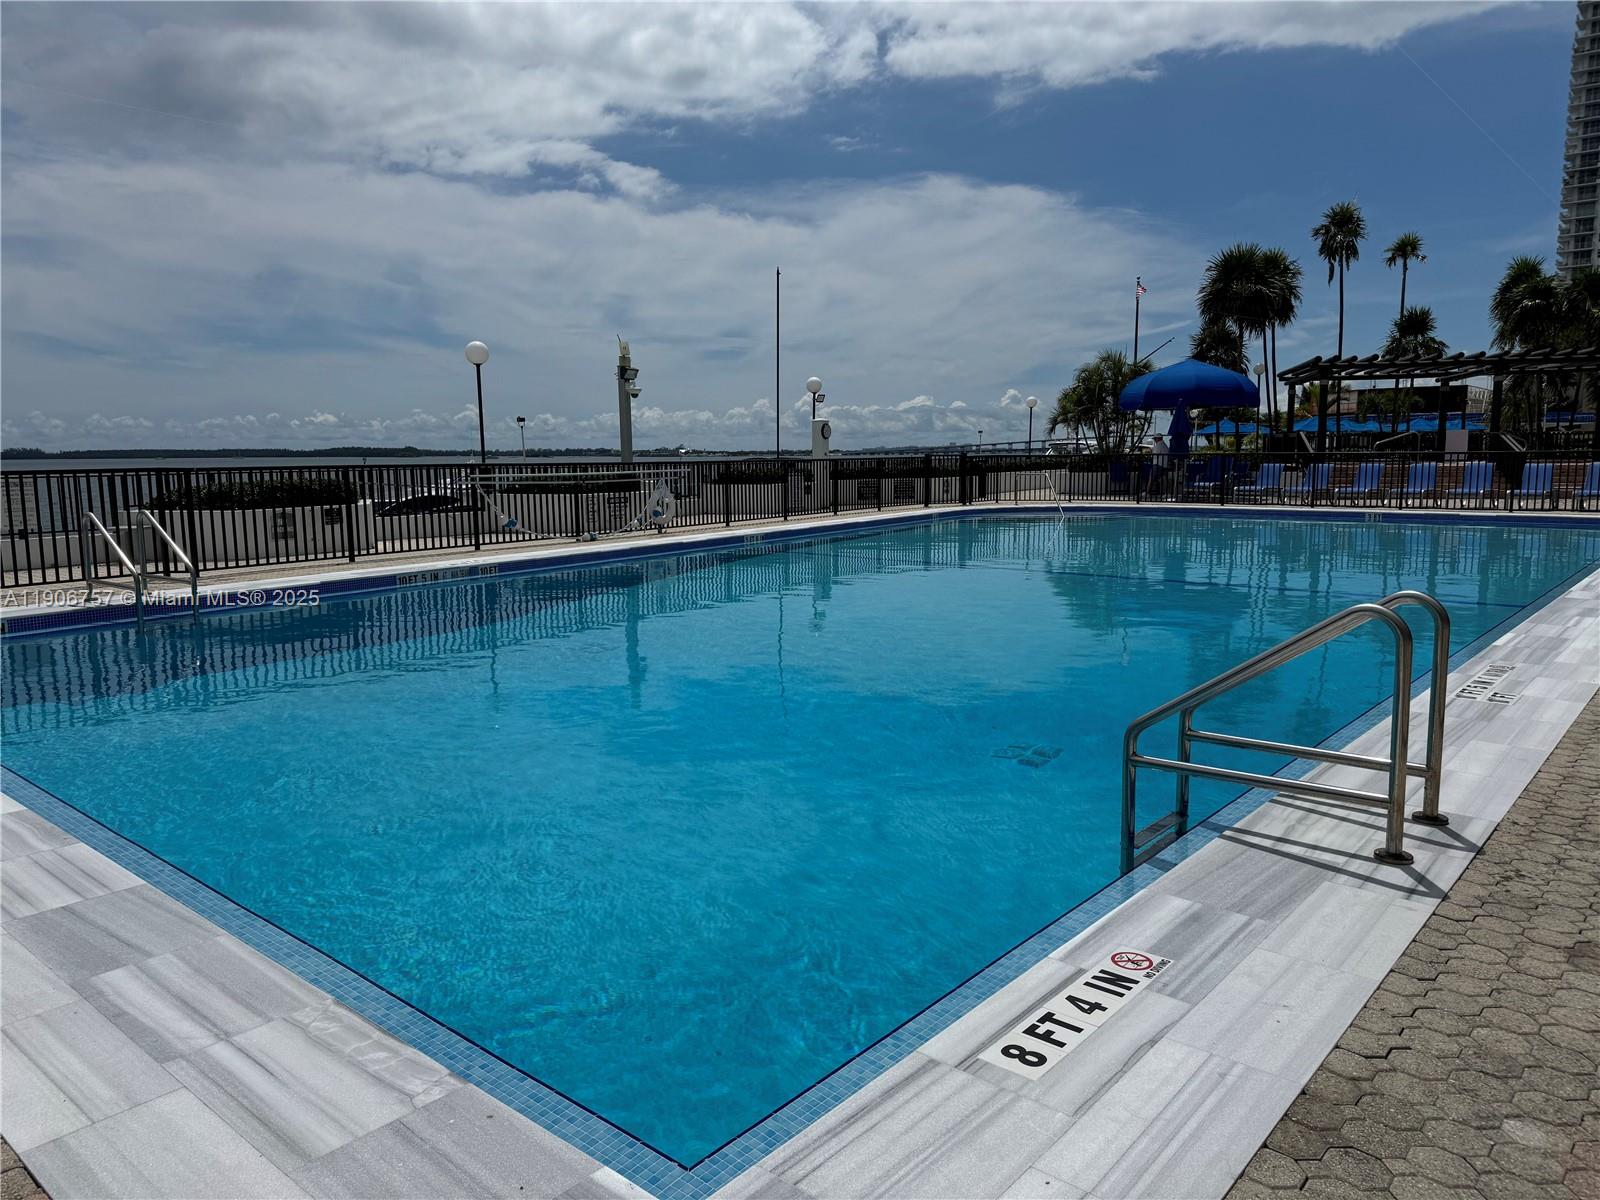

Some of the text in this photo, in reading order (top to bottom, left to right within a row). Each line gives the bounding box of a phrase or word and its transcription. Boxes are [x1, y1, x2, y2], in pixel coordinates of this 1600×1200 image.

[1143, 971, 1156, 980] NO
[1000, 968, 1141, 1068] 8 FT 4 IN
